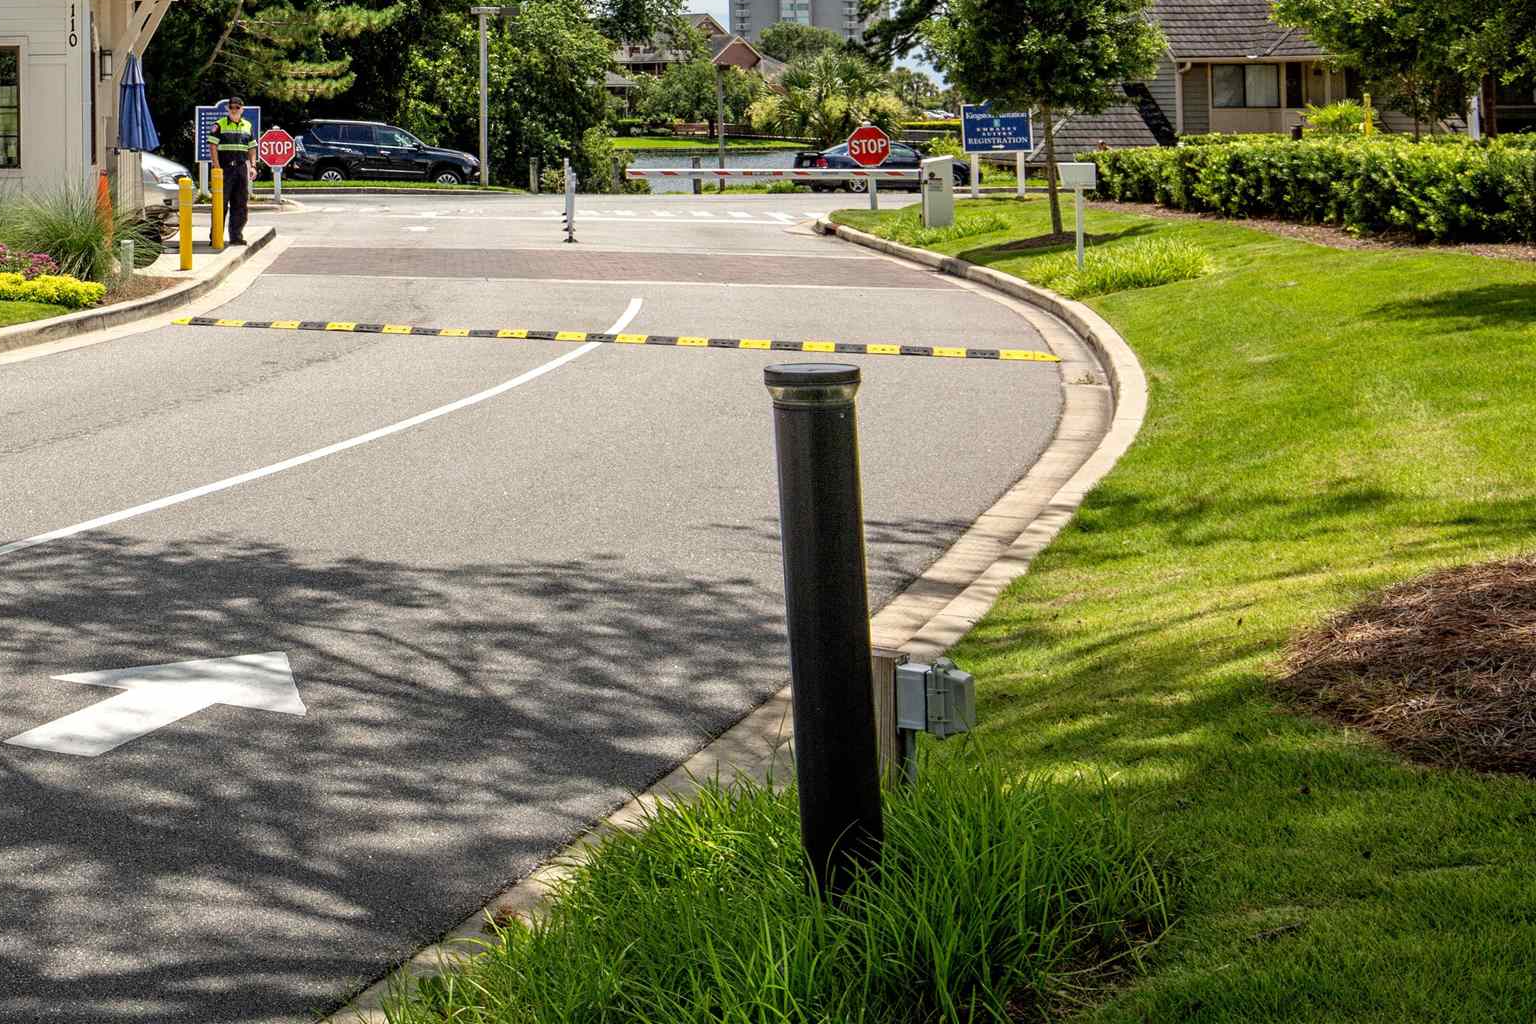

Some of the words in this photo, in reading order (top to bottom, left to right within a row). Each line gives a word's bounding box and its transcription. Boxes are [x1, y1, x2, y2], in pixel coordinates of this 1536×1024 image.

[69, 3, 77, 47] 110
[261, 141, 292, 155] STOP
[851, 138, 887, 155] STOP
[968, 136, 1029, 145] REGISTRATION
